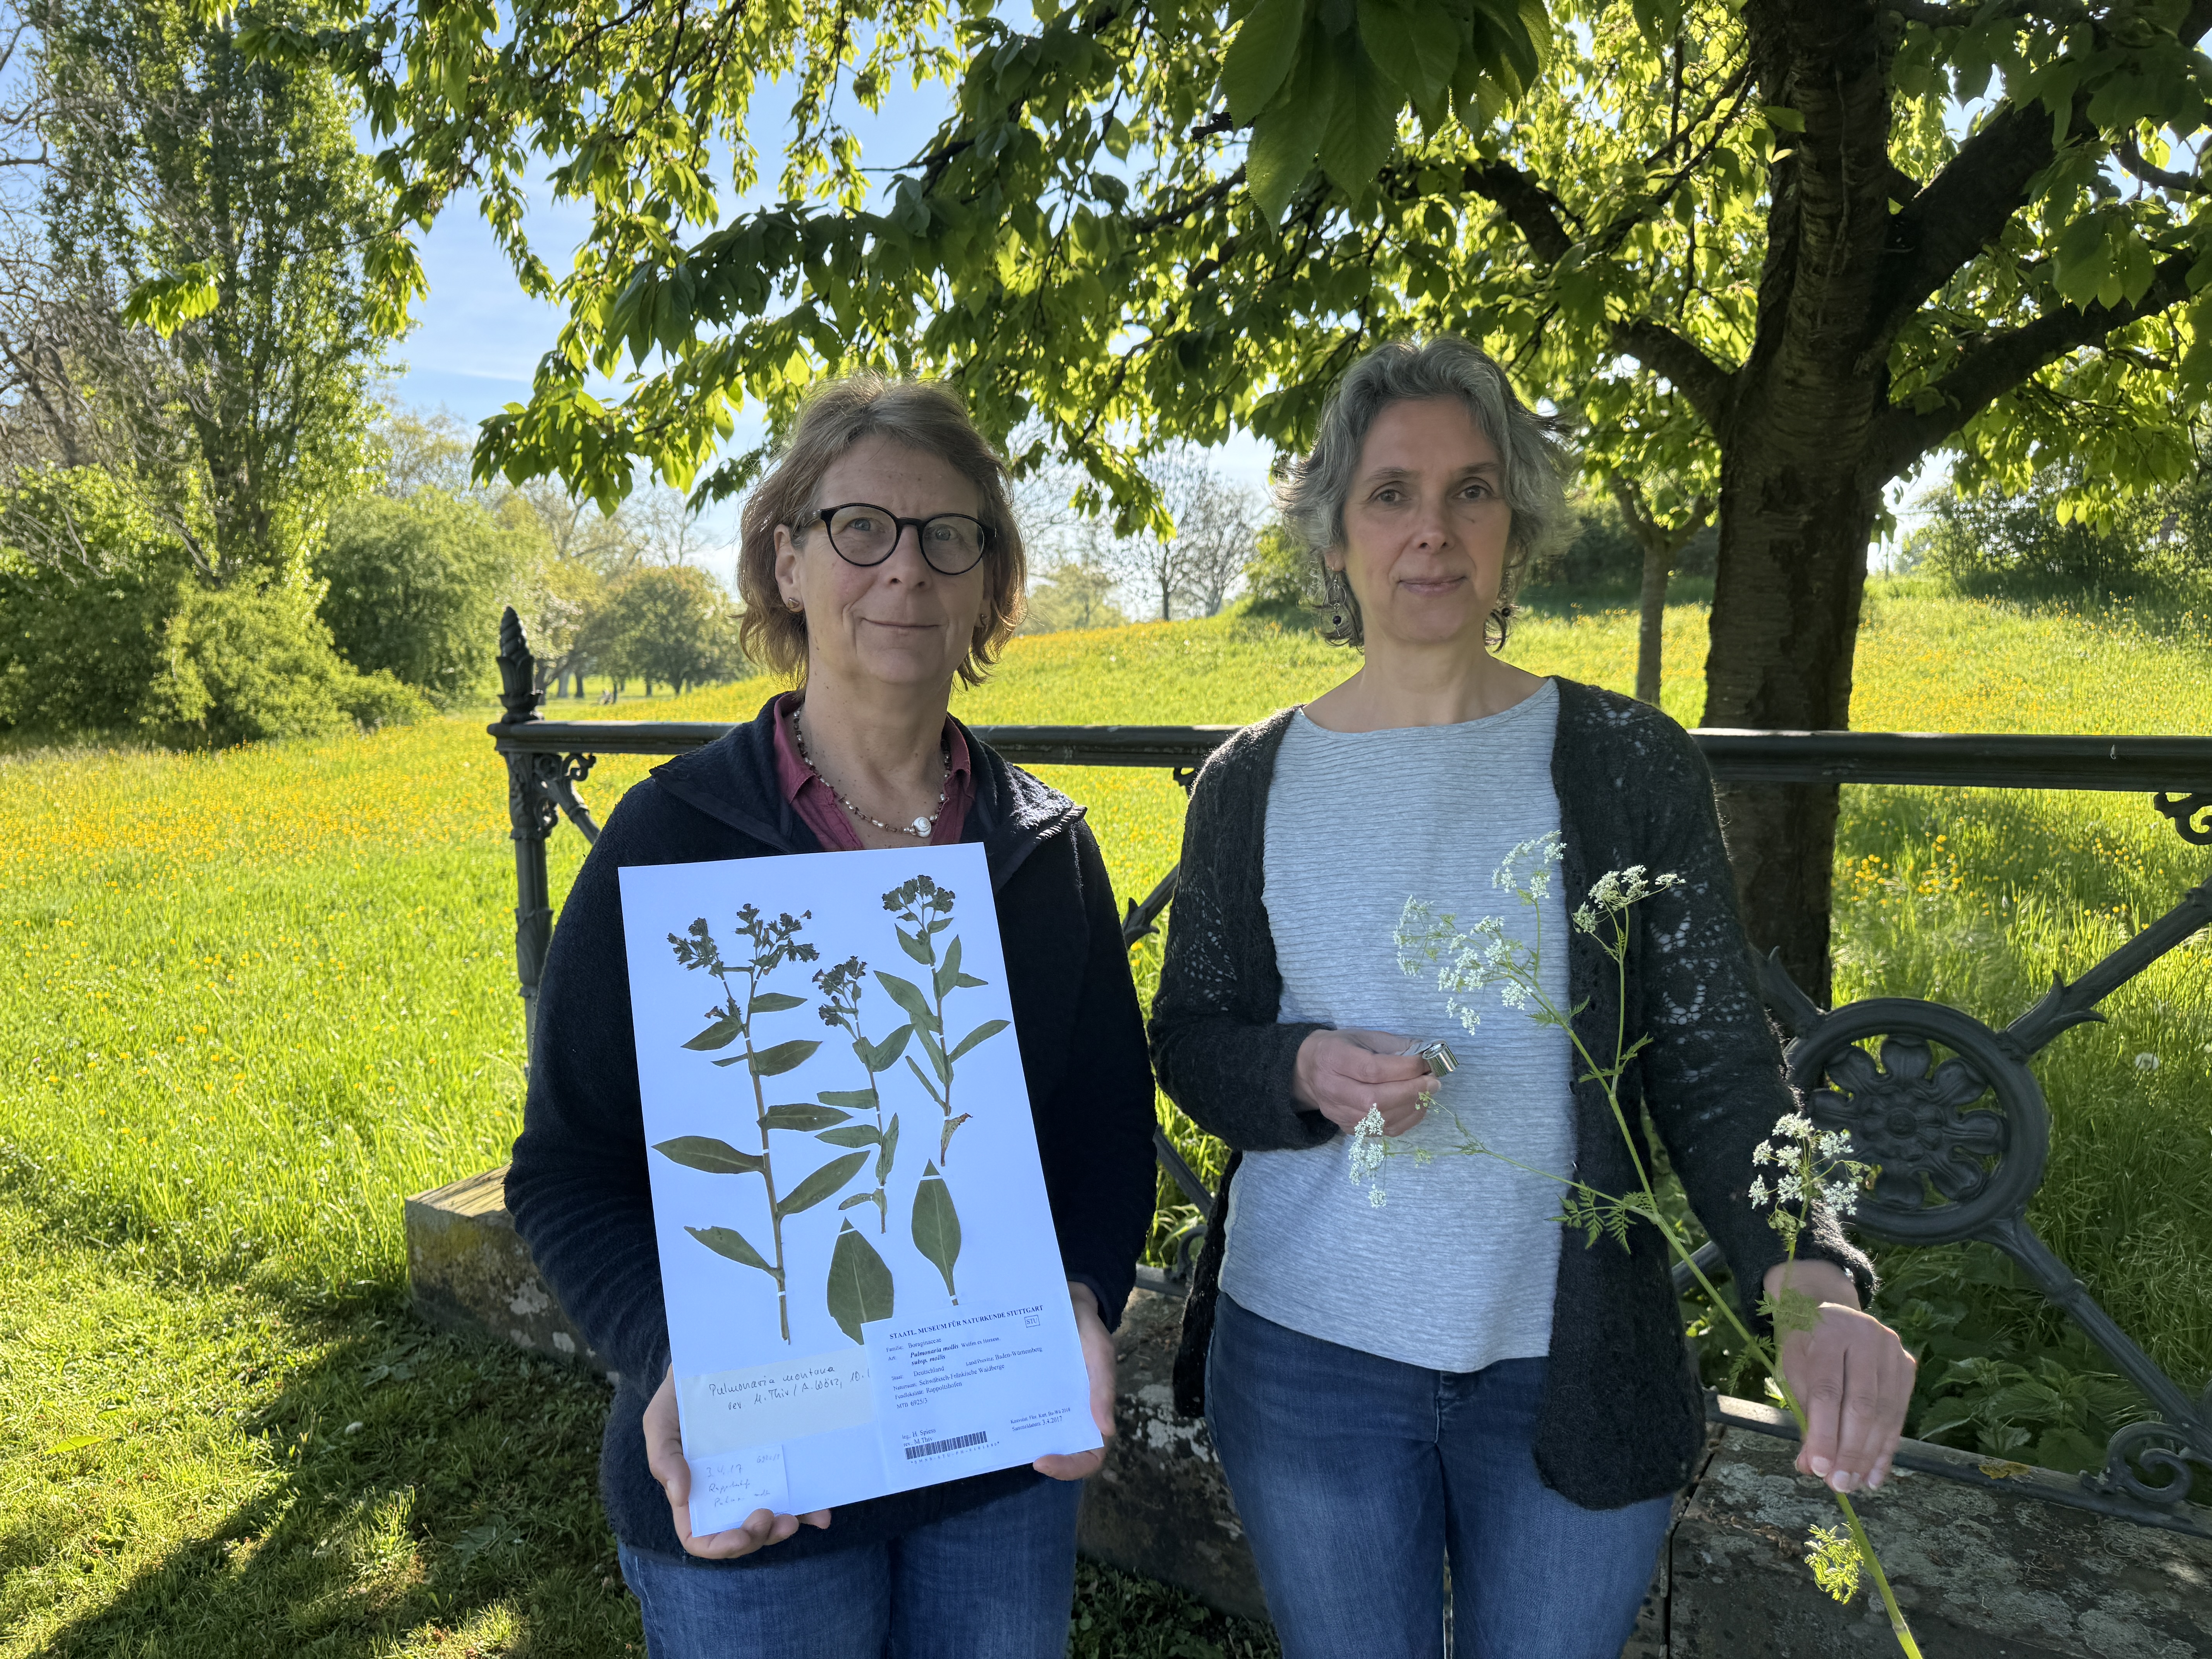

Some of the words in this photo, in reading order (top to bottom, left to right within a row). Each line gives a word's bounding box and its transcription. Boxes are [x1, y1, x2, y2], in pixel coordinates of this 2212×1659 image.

[890, 1330, 917, 1339] STAATL.
[918, 1323, 947, 1334] MUSEUM
[948, 1320, 961, 1328] FÜR
[962, 1312, 1005, 1325] NATURKUNDE
[1006, 1305, 1043, 1317] STUTTGART
[908, 1338, 941, 1348] Boraginaceae
[910, 1347, 941, 1358] Pulmonaria
[943, 1343, 958, 1352] mollis
[911, 1357, 927, 1366] subsp.
[914, 1365, 945, 1377] Deutschland
[995, 1347, 1042, 1360] Baden-Württemberg
[709, 1376, 775, 1397] Pulmonaria
[782, 1366, 835, 1382] montana
[919, 1370, 977, 1386] Schwäbisch-Fränkische
[978, 1364, 1005, 1373] Waldberge
[768, 1388, 789, 1399] Thiv
[802, 1384, 813, 1393] A.
[926, 1381, 962, 1393] Rappoltshofen
[910, 1398, 927, 1406] 6925/3
[1042, 1416, 1062, 1425] 3.4.2017
